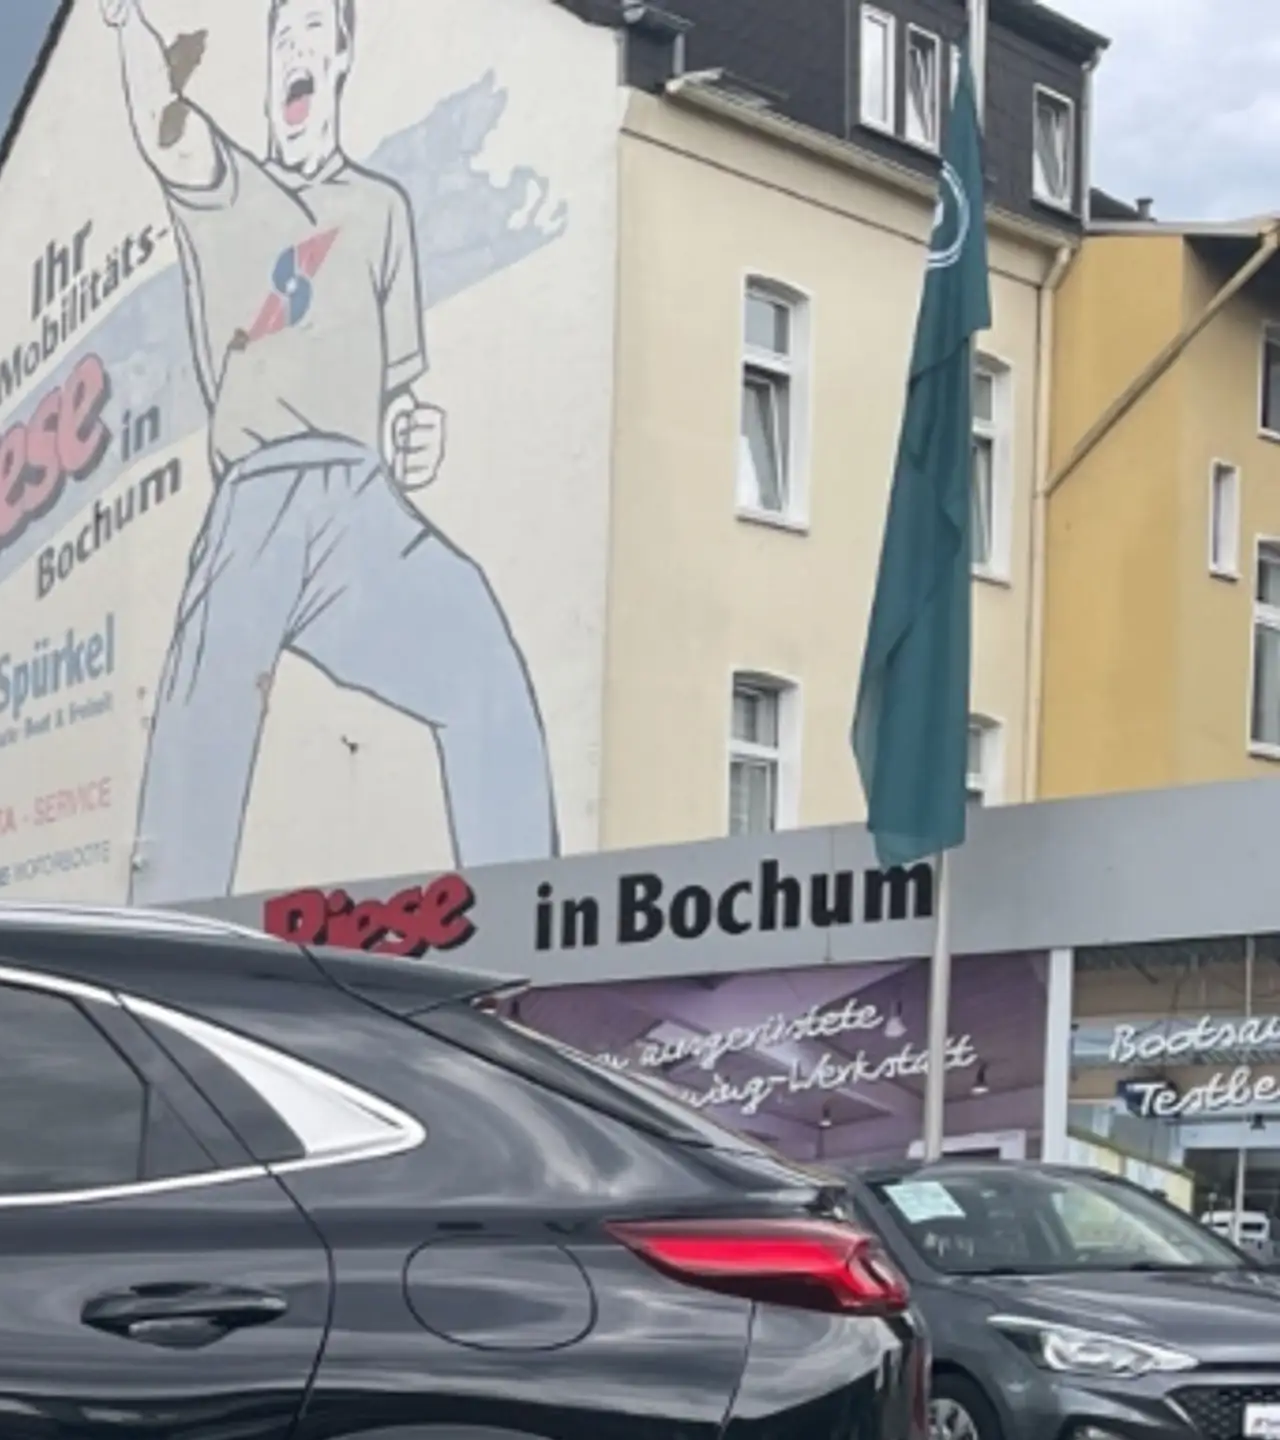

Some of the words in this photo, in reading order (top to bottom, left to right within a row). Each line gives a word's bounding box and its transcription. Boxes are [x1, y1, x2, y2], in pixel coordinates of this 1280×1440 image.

[31, 219, 94, 322] Ihr
[121, 404, 161, 463] in
[36, 455, 183, 602] Bochum
[534, 880, 599, 951] in
[616, 859, 933, 945] Bochum
